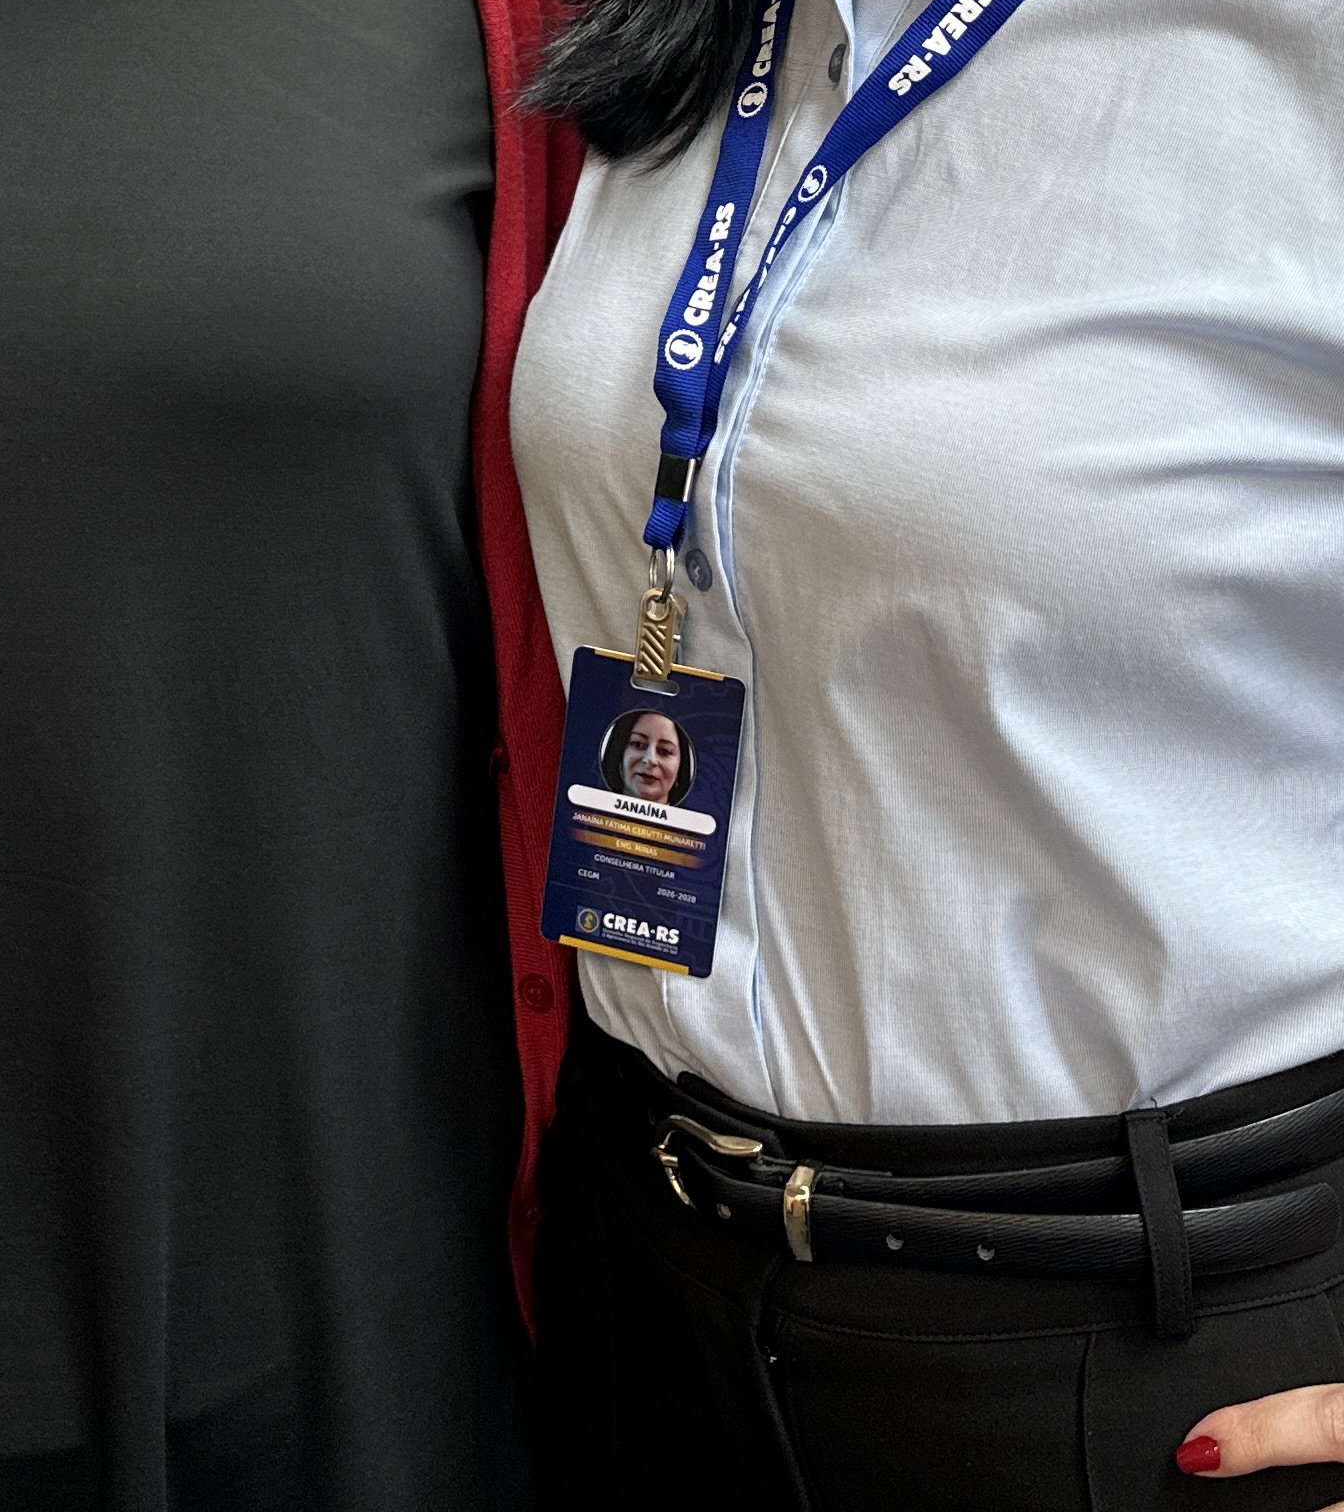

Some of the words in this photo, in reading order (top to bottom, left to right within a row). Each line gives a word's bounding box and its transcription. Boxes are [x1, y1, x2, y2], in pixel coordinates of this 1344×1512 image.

[614, 798, 668, 820] JANAÍNA
[572, 812, 604, 826] JANAÍNA
[633, 843, 658, 856] MINAS
[594, 853, 645, 872] CONSELHEIRA
[645, 865, 676, 880] TITULAR
